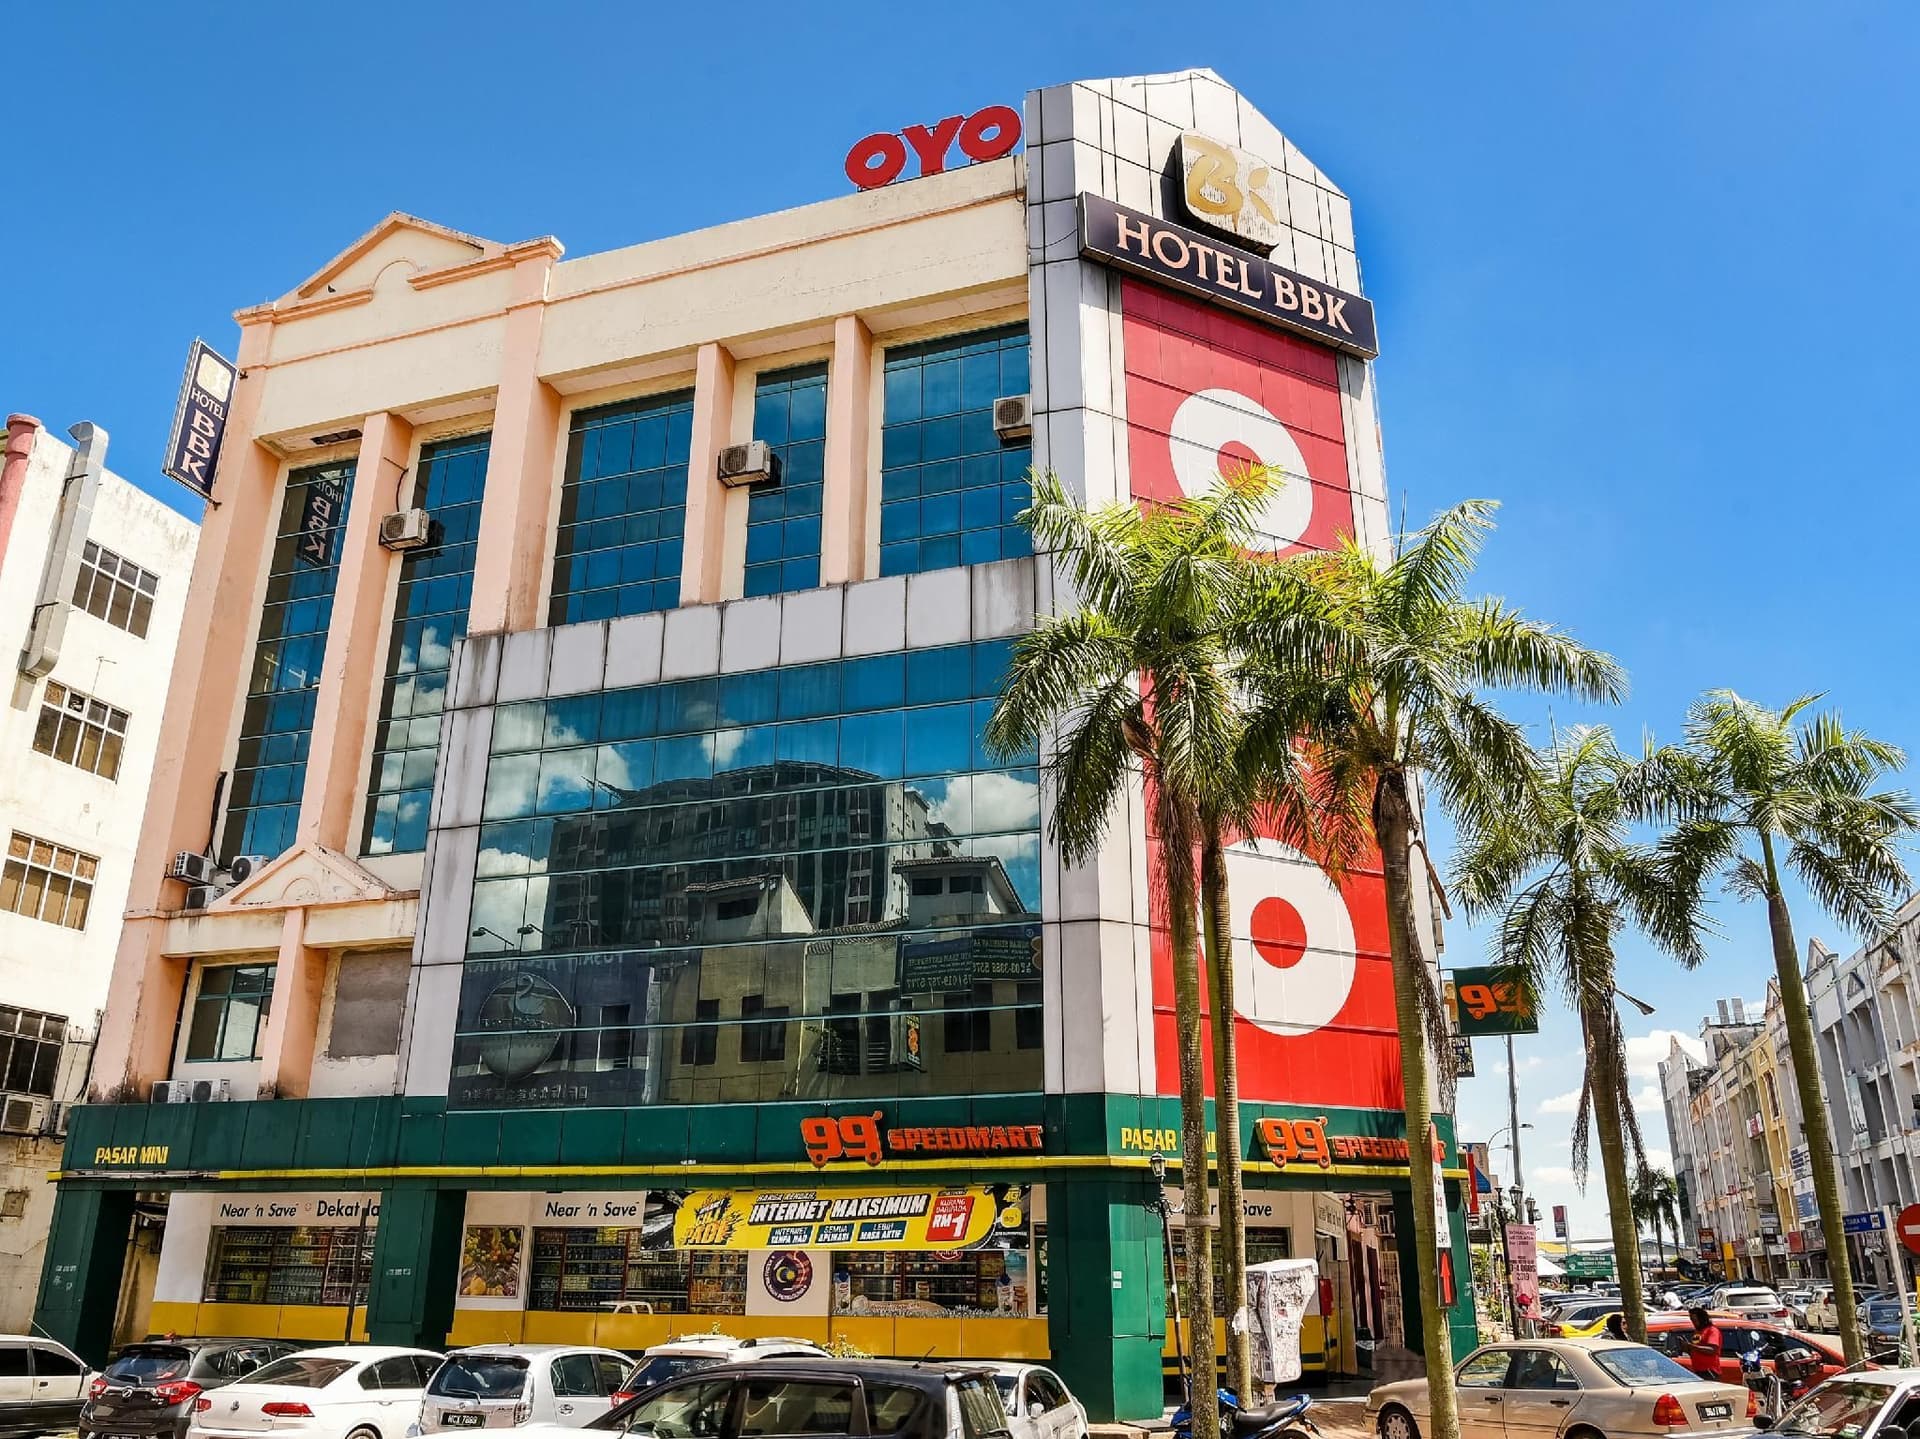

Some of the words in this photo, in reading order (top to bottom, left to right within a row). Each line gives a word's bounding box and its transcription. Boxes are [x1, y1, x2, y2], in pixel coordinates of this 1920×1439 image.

[844, 104, 1022, 190] OYO
[1116, 212, 1263, 299] HOTEL
[1271, 271, 1353, 335] BBK
[191, 387, 225, 421] HOTEL
[180, 409, 215, 484] BBK
[800, 1110, 883, 1168] 99
[888, 1124, 1044, 1150] SPEEDMART
[1121, 1128, 1177, 1151] PASAR
[1257, 1116, 1331, 1169] 99
[95, 1147, 138, 1164] PASAR
[140, 1146, 168, 1164] MINI
[220, 1203, 249, 1217] Near
[268, 1203, 296, 1217] Save
[317, 1198, 360, 1217] Dekat
[546, 1202, 580, 1217] Near
[603, 1202, 637, 1217] Save
[750, 1201, 829, 1223] INTERNET
[831, 1194, 927, 1217] MAKSIMUM
[824, 1225, 848, 1233] SEMUA
